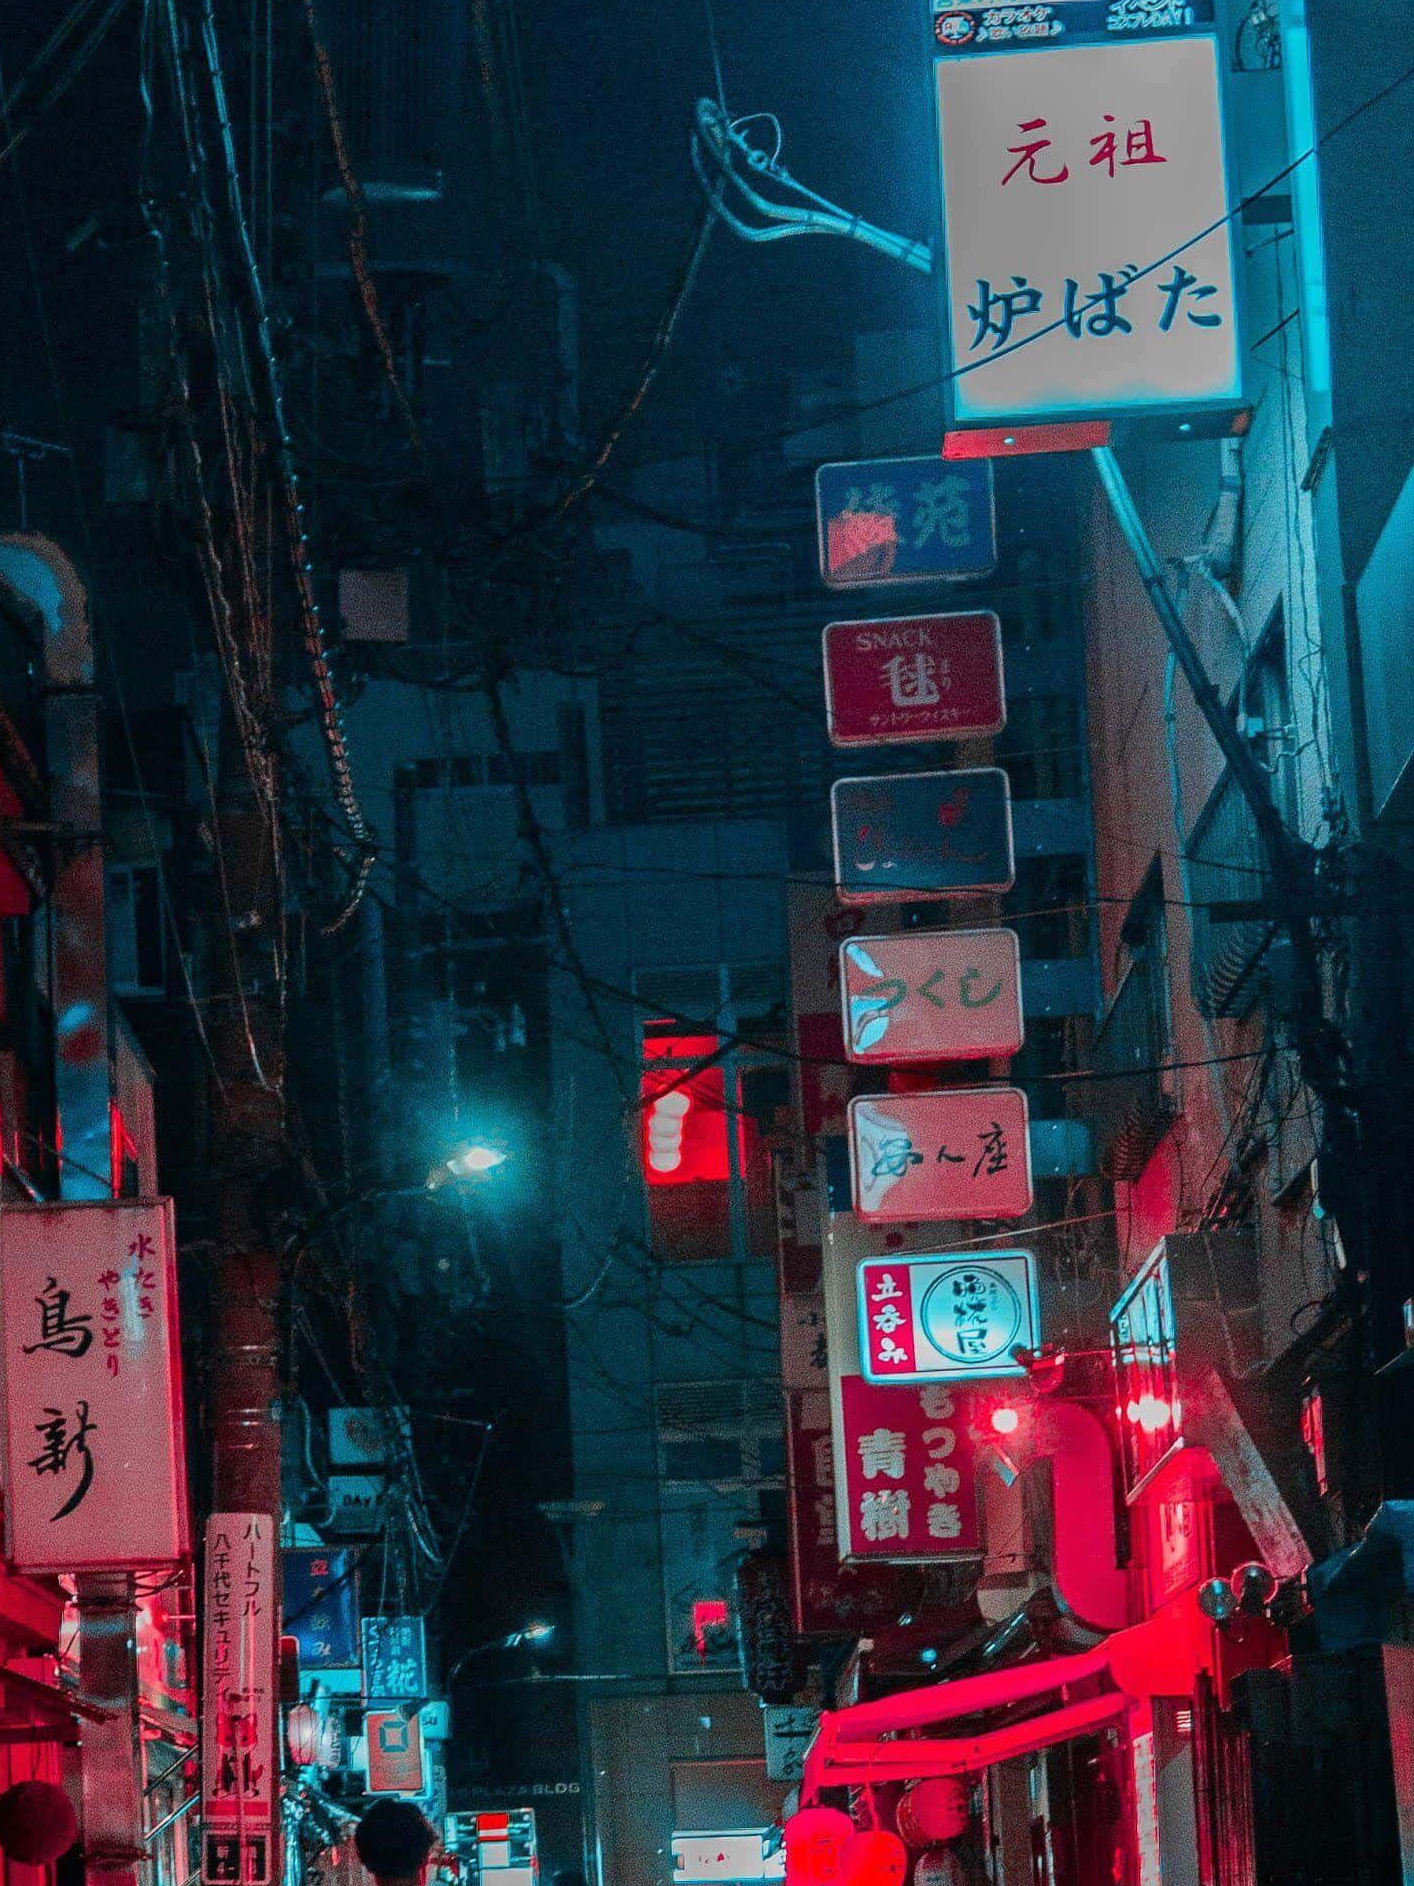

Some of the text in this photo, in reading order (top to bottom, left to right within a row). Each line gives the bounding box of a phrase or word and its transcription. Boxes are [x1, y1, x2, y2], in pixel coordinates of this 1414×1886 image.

[983, 5, 1052, 27] カラオケ
[999, 113, 1170, 188] 元祖
[966, 262, 1224, 353] 炉ばた
[856, 629, 933, 653] SNACK
[97, 1268, 123, 1378] やきとり
[871, 1273, 909, 1365] 立呑み
[242, 1522, 263, 1617] ハートフル
